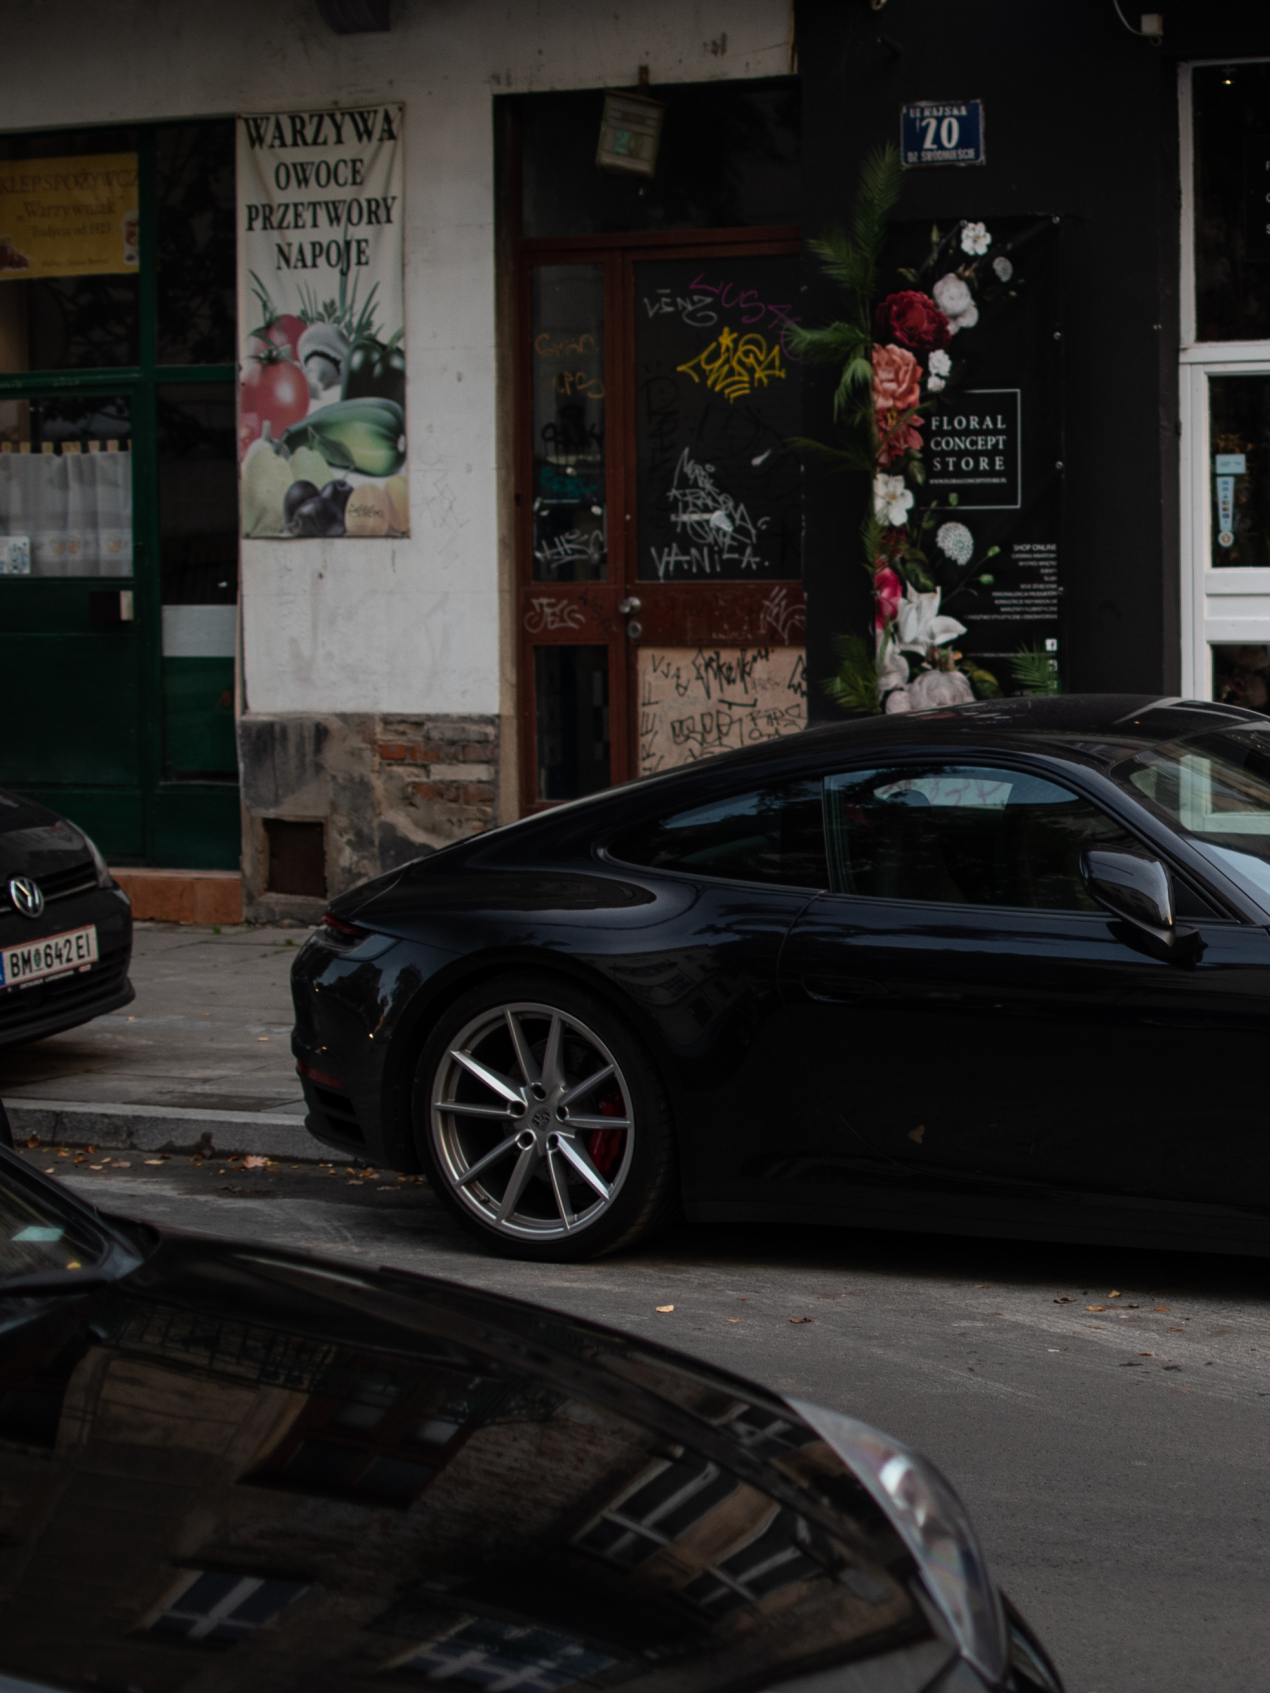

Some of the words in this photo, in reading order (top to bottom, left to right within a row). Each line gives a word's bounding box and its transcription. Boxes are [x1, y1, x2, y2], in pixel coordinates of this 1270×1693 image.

[243, 108, 397, 150] WARZYWA
[920, 116, 960, 150] 20
[275, 158, 364, 191] OWOCE
[246, 196, 397, 231] PRZETWORY
[275, 238, 369, 276] NAPOJE
[930, 414, 1007, 431] FLORAL
[930, 435, 1007, 451] CONCEPT
[932, 456, 1005, 472] STORE
[1032, 543, 1057, 551] ONLINE
[10, 949, 33, 978] BM
